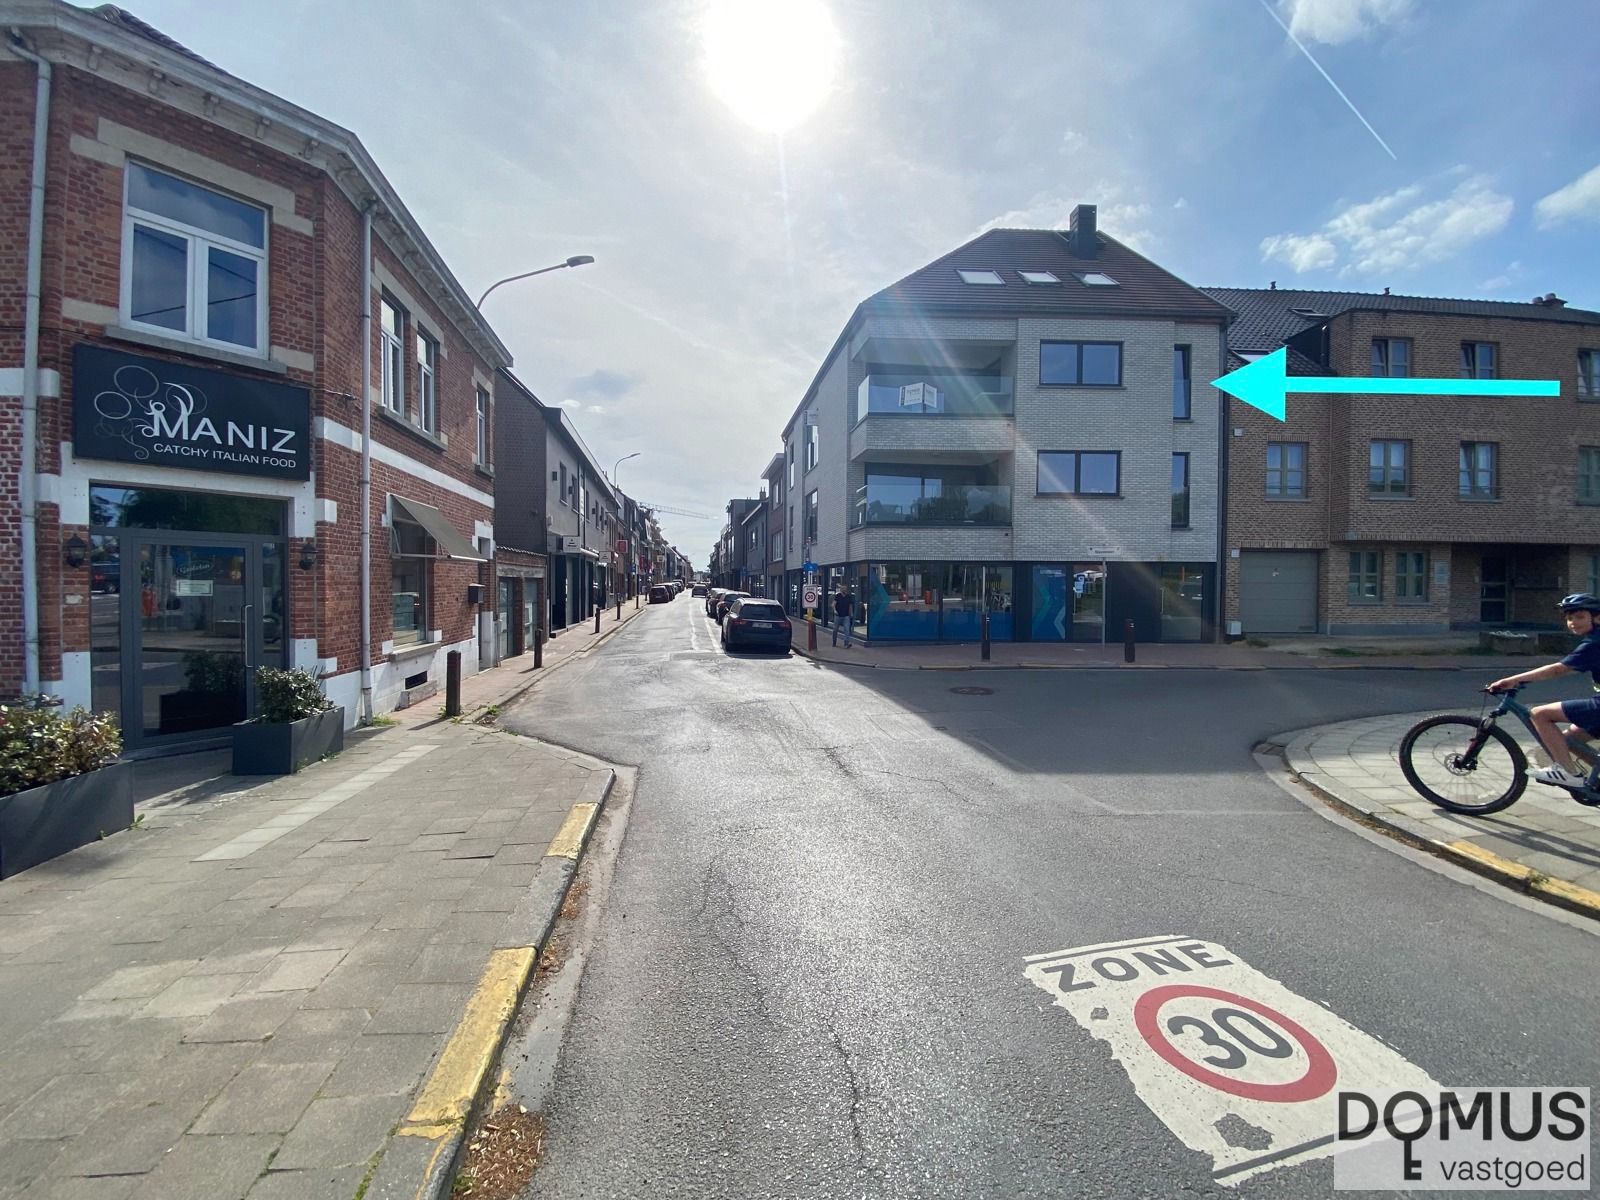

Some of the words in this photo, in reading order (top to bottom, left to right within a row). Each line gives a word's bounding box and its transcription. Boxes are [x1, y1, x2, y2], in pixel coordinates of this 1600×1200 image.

[148, 396, 297, 455] MANIZ
[153, 443, 208, 459] CATCHY
[211, 450, 260, 465] ITALIAN
[262, 455, 297, 469] FOOD
[1041, 943, 1233, 993] ZONE
[1166, 1007, 1294, 1070] 30
